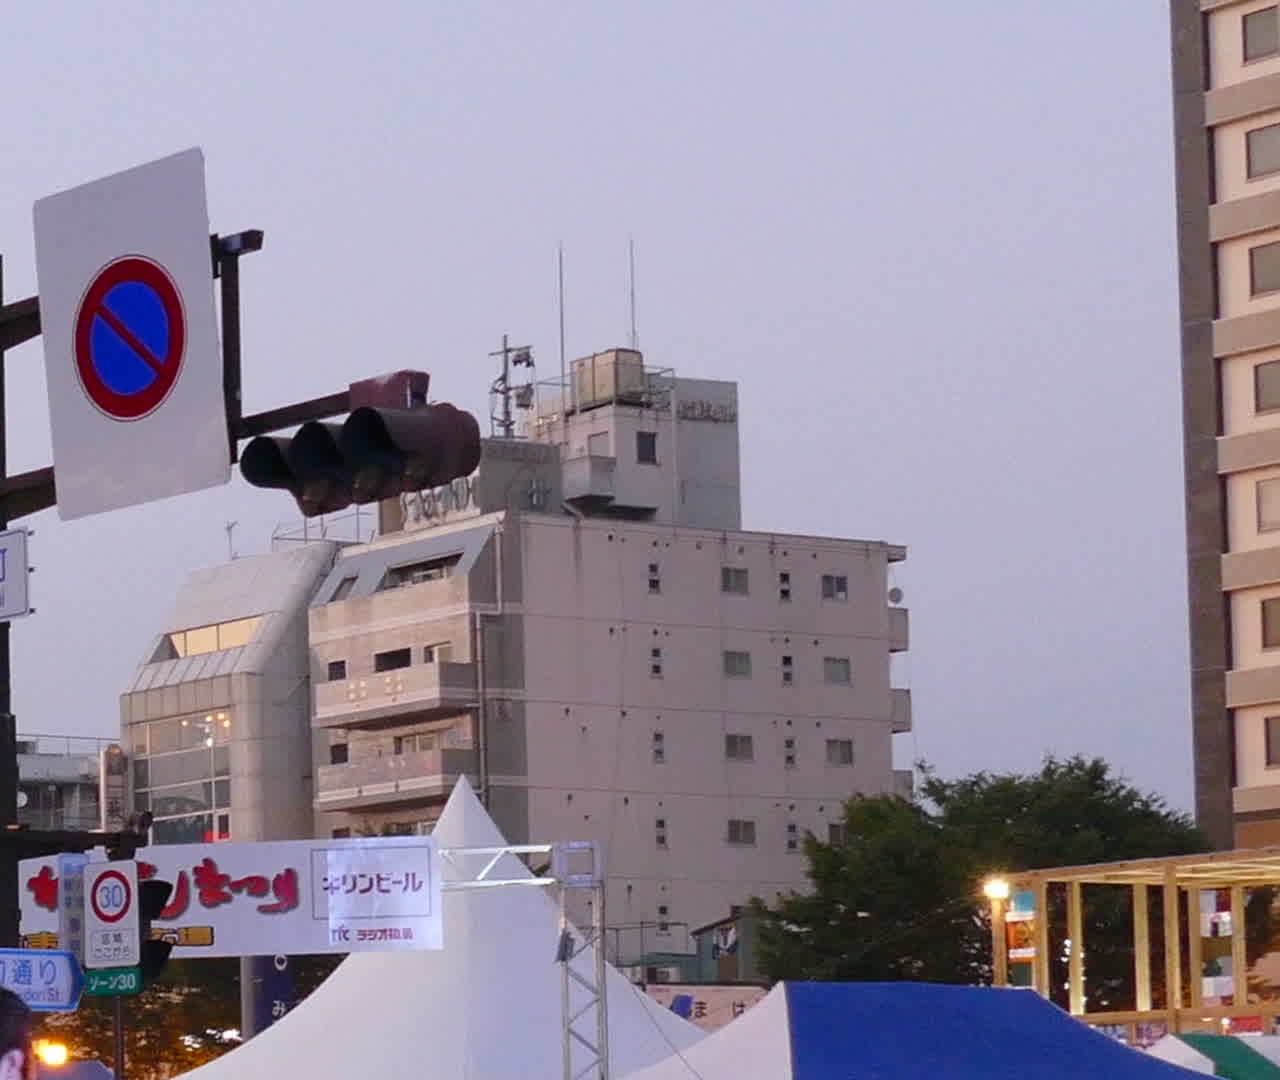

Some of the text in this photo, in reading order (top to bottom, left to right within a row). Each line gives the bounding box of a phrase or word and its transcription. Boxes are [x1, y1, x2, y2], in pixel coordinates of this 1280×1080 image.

[323, 871, 424, 896] キリンビール
[99, 884, 123, 909] 30
